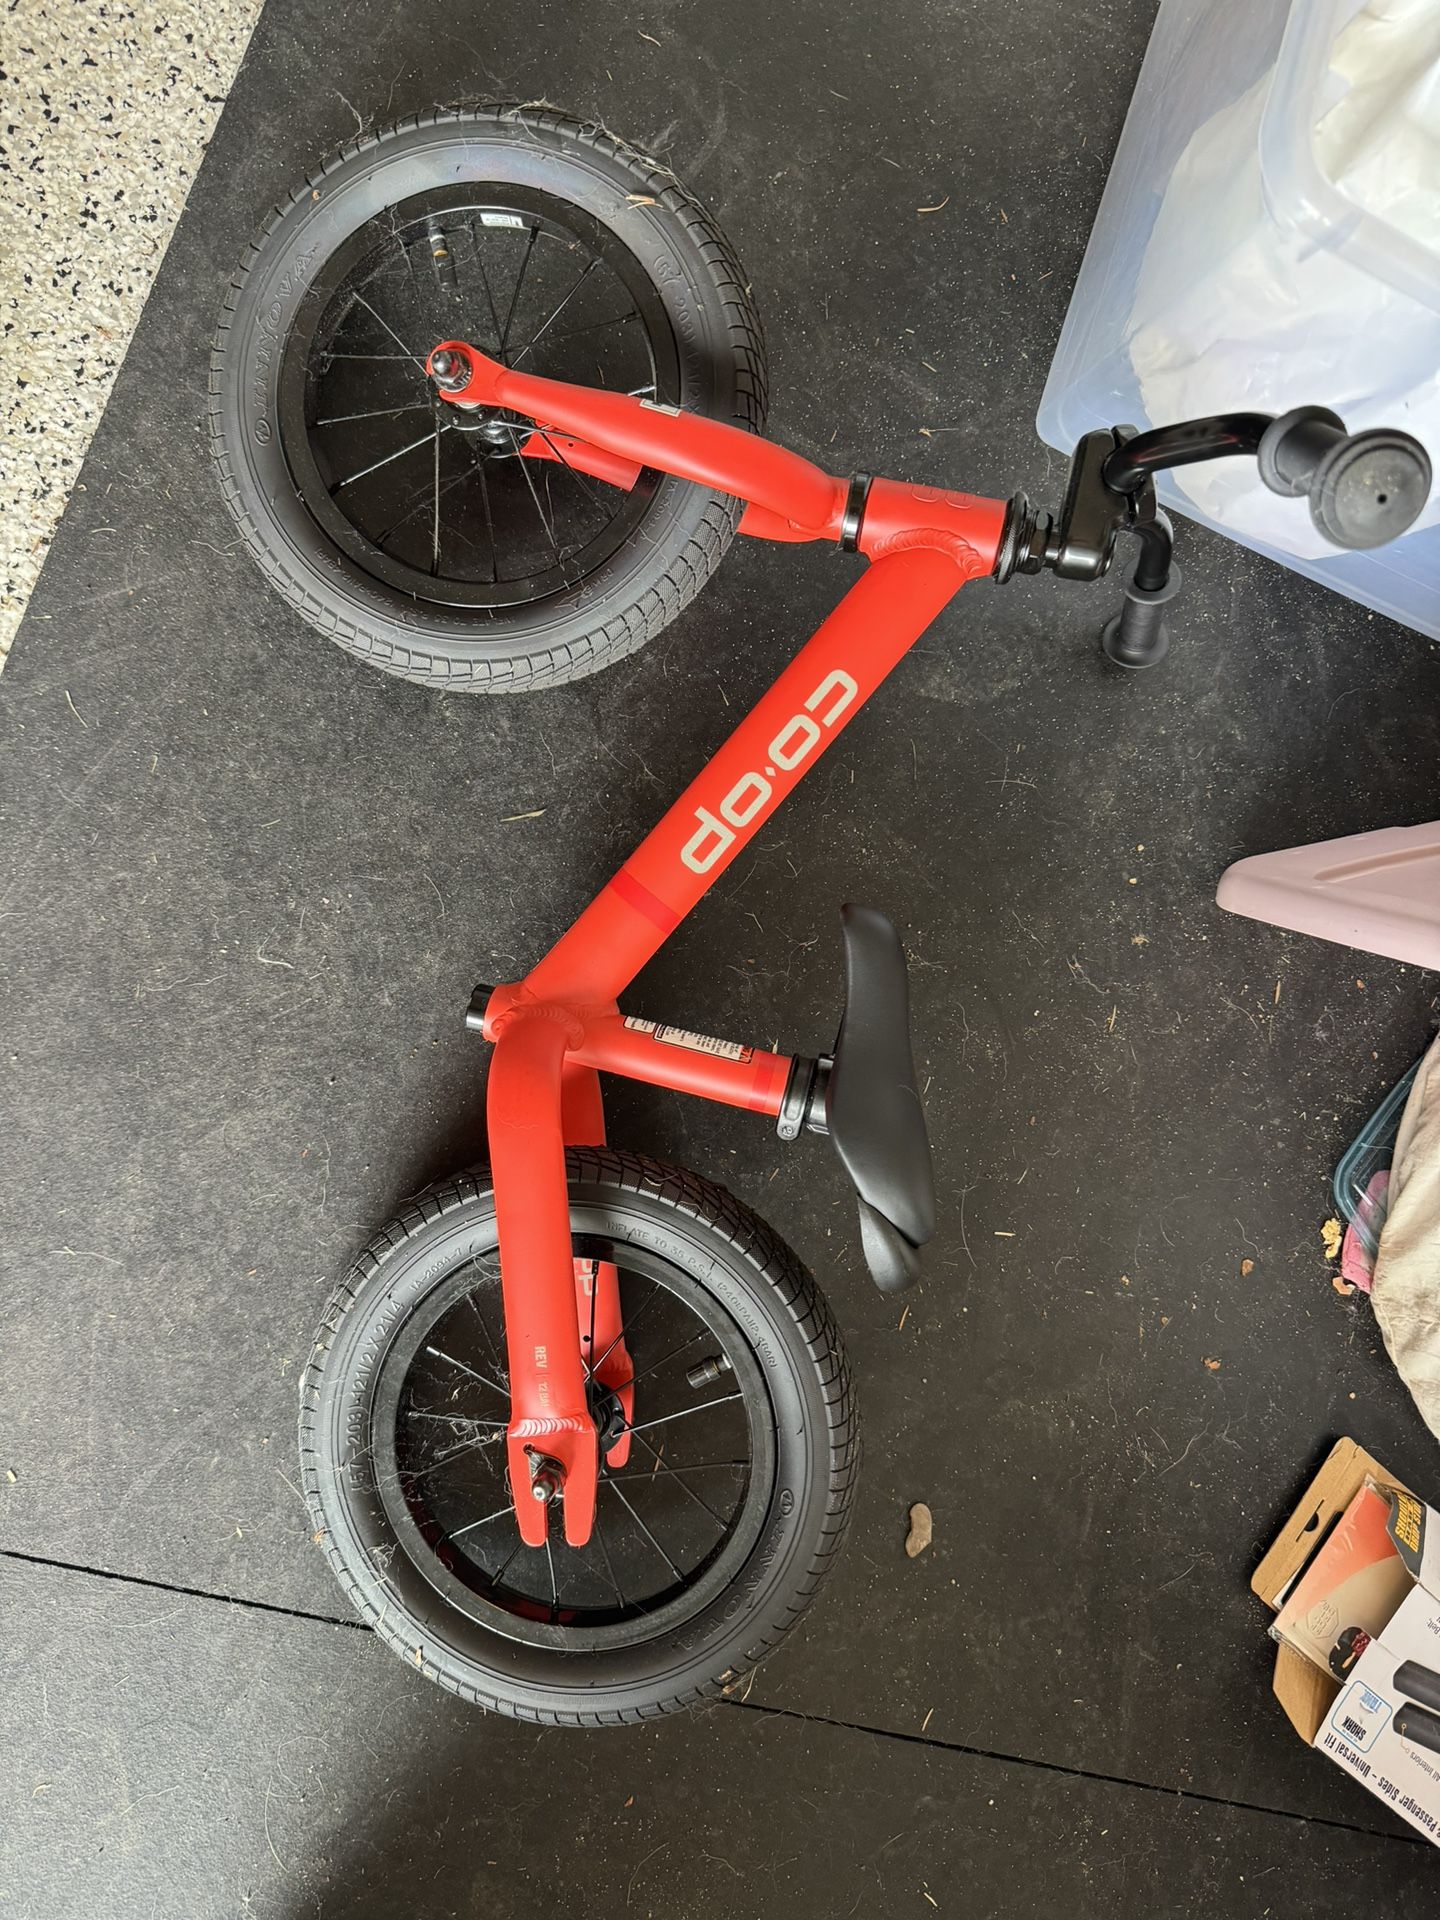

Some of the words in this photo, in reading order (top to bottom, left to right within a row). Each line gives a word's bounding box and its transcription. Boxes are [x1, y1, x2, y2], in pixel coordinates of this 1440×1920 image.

[253, 245, 314, 409] INNOVA
[605, 1221, 651, 1241] INFLATE
[651, 1235, 669, 1249] TO
[668, 1243, 687, 1260] 35
[535, 1346, 547, 1368] REV
[680, 1523, 787, 1653] INNOVA
[1324, 1733, 1337, 1749] Fit
[1341, 1716, 1367, 1741] SHARK
[1334, 1742, 1371, 1778] Universal
[1410, 1752, 1434, 1776] Interiors
[1377, 1777, 1400, 1801] Sides
[1399, 1795, 1438, 1832] Passenger
